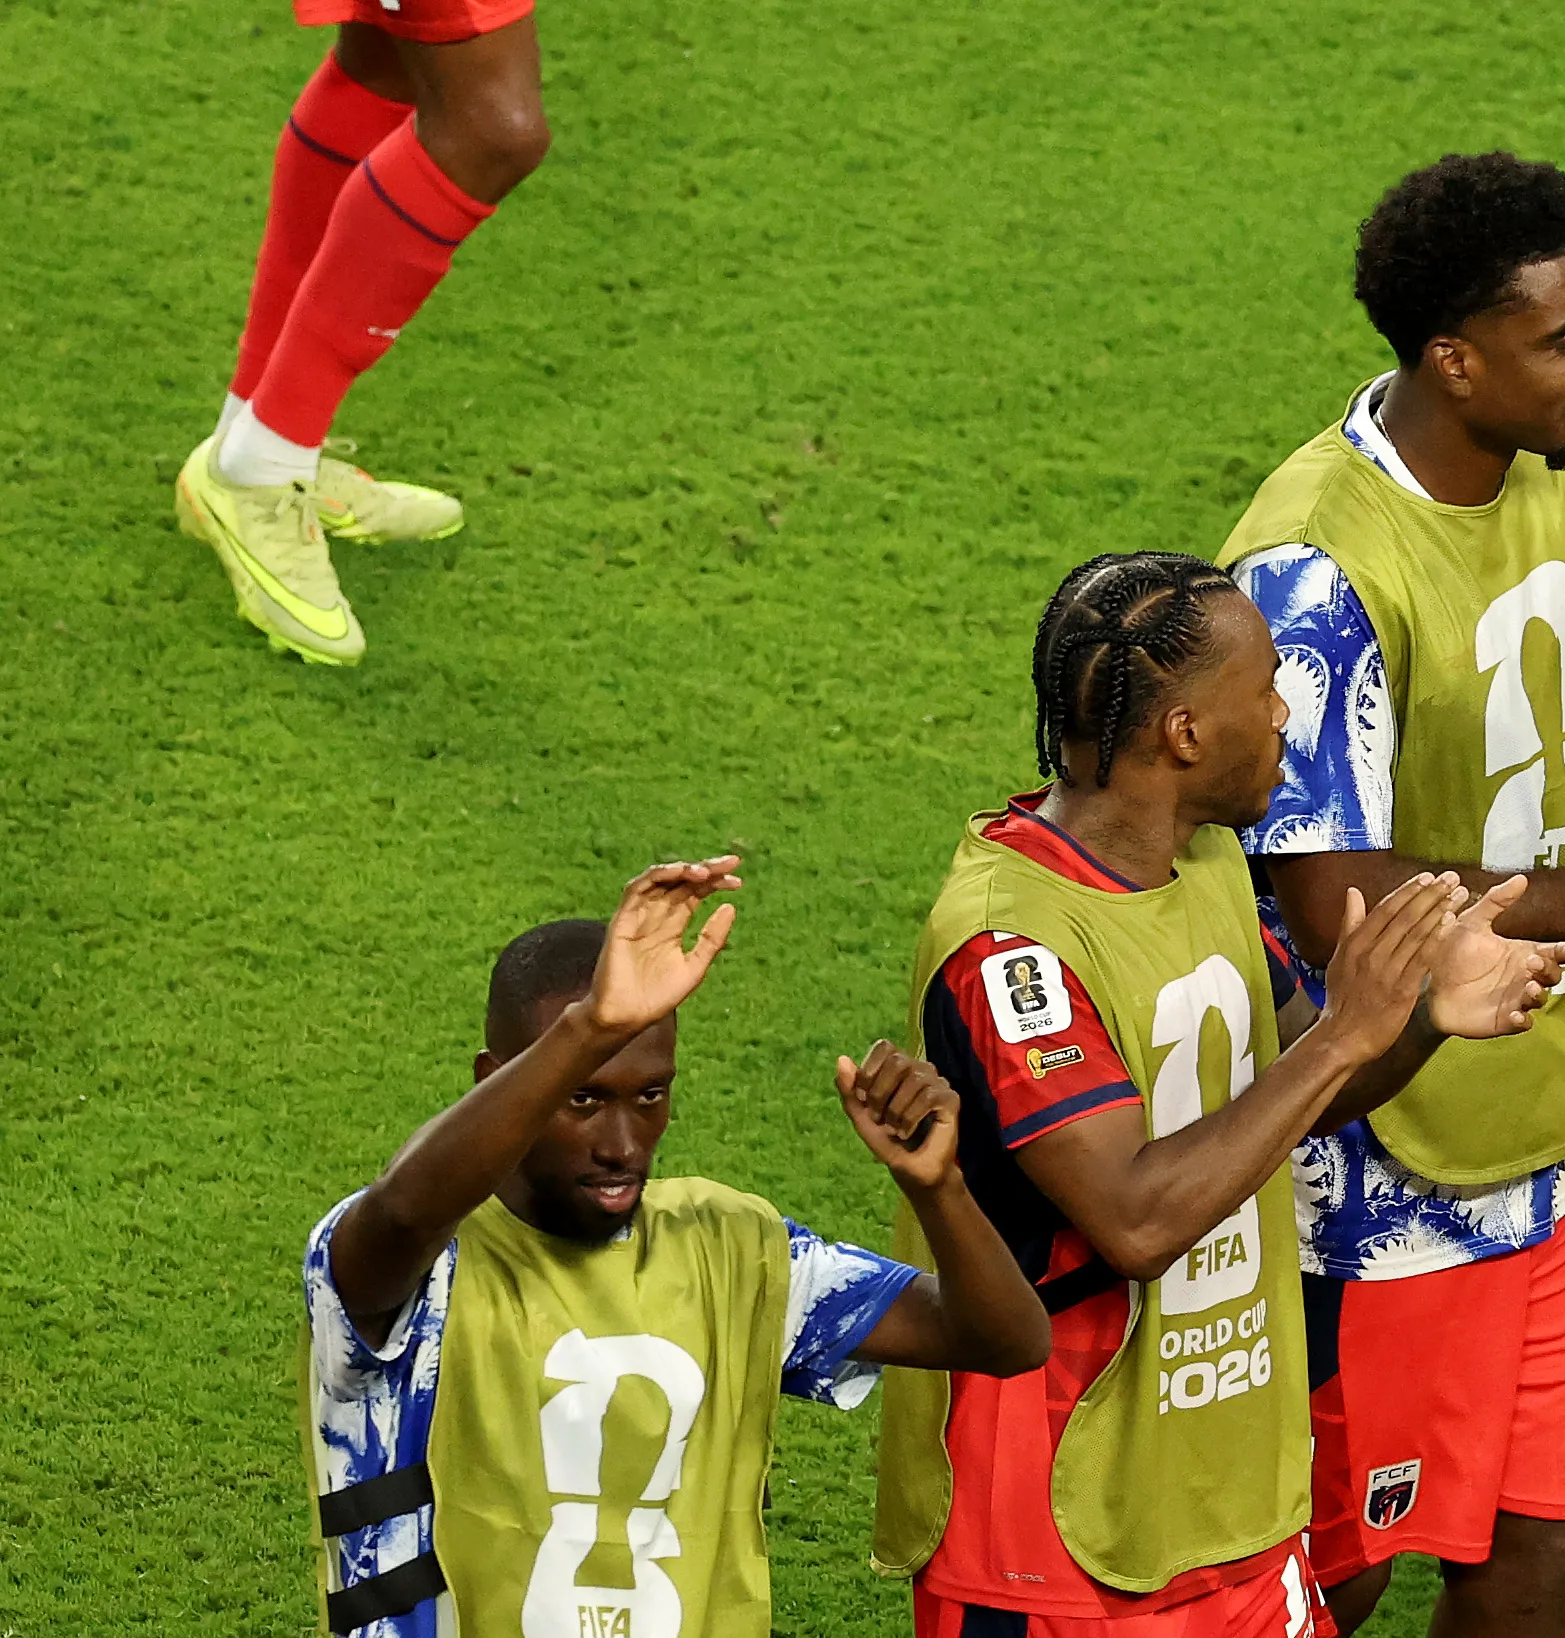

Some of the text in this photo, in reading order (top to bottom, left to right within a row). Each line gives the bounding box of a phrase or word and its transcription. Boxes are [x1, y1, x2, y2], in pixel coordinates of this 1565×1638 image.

[1020, 1018, 1053, 1032] 2026
[1187, 1232, 1249, 1282] FIFA
[1160, 1298, 1267, 1360] ORLD CUP
[1374, 1464, 1417, 1484] FCF
